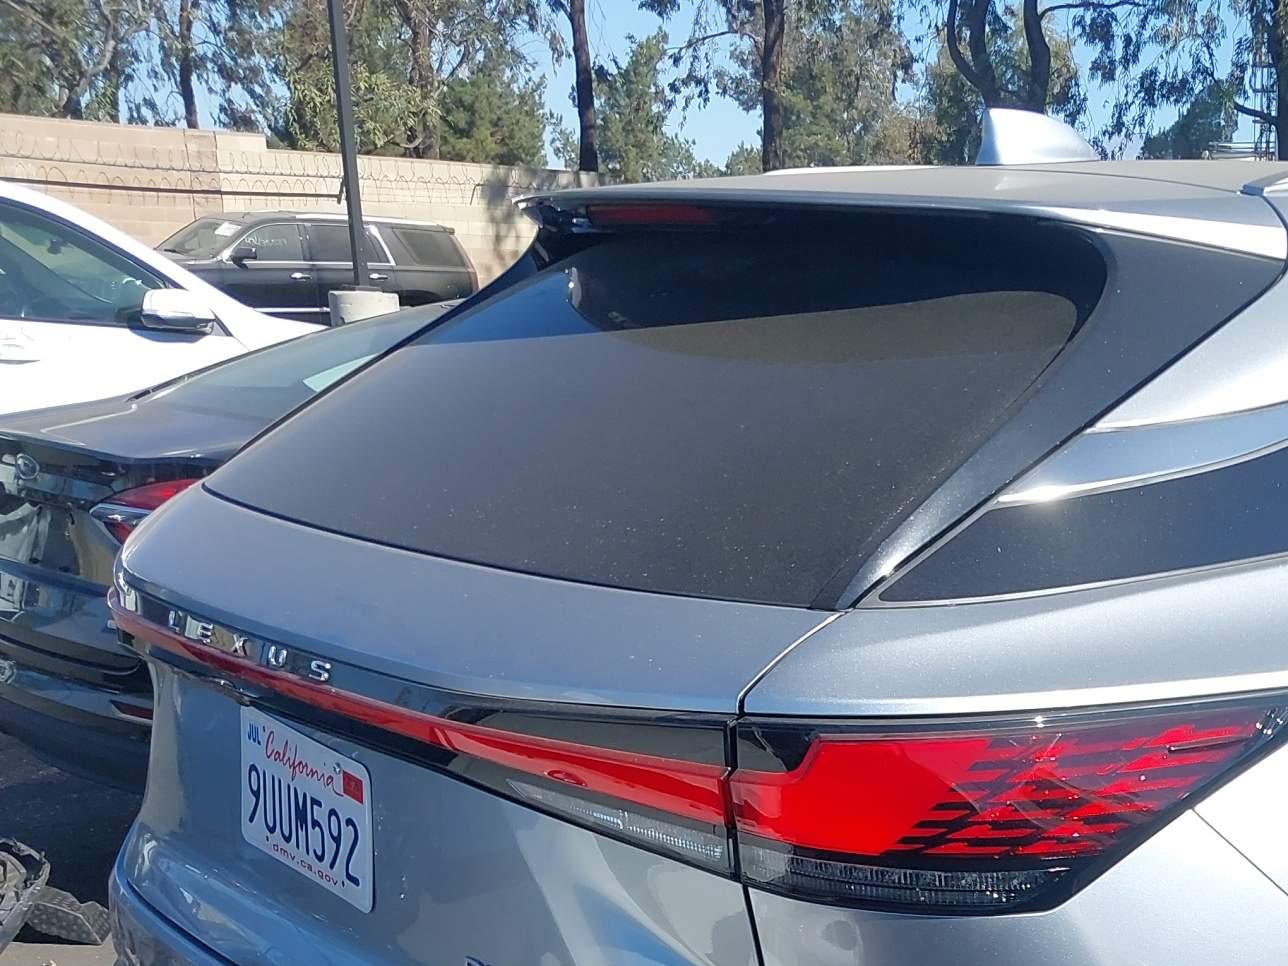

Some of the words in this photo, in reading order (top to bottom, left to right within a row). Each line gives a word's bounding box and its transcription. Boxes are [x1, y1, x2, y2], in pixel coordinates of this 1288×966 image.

[168, 610, 332, 682] LEXUS
[247, 723, 262, 746] JUL
[265, 731, 344, 797] California
[248, 763, 360, 887] 9UUM592
